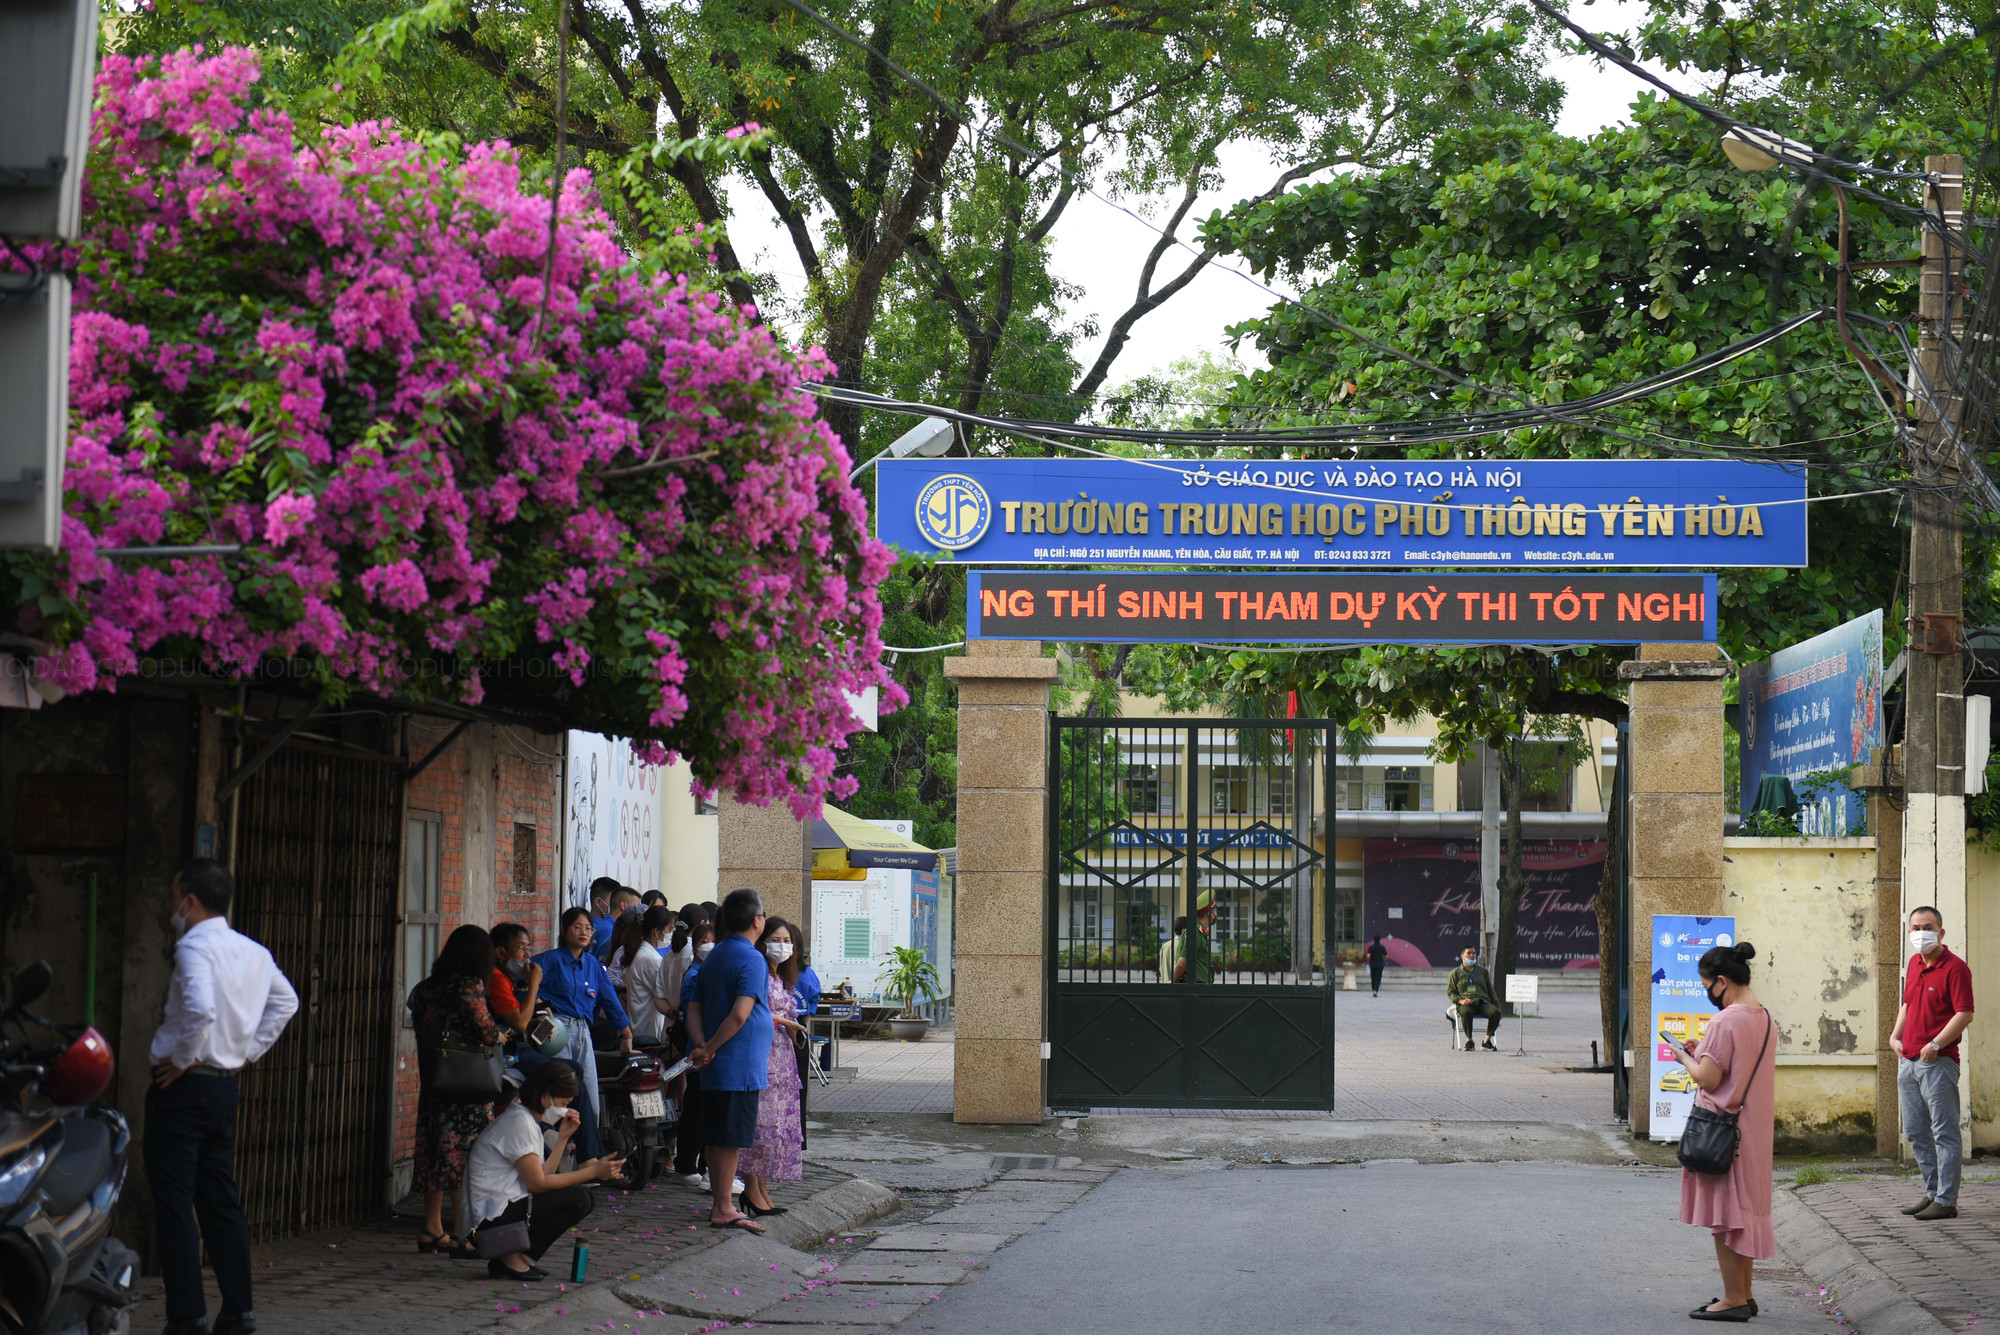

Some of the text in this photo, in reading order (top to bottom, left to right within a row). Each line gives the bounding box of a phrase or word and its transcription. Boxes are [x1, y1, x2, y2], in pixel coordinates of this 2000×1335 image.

[1182, 464, 1210, 487] SỞ
[1216, 464, 1268, 487] GIÁO
[1324, 465, 1348, 487] VÀ
[1354, 465, 1397, 487] ĐÀO
[1404, 471, 1443, 493] TẠO
[1451, 465, 1478, 487] HÀ
[1486, 466, 1521, 493] NỘI
[1000, 490, 1764, 543] TRƯỜNG TRUNG HỌC PHỔ THÔNG YÊN HÒA
[1034, 548, 1049, 560] ĐỊA
[1089, 549, 1105, 558] 251
[1106, 546, 1141, 559] NGUYỄN
[1142, 550, 1174, 560] KHANG,
[1175, 547, 1192, 559] YÊN
[1193, 547, 1213, 560] HÒA,
[1214, 547, 1232, 559] CẦU
[1233, 547, 1253, 560] GIẤY,
[1256, 549, 1269, 559] TP.
[1270, 548, 1282, 560] HÀ
[1284, 548, 1300, 561] NỘI
[1314, 550, 1328, 560] ĐT:
[1328, 550, 1351, 560] 0243
[1352, 550, 1370, 560] 833
[1370, 550, 1391, 560] 3721
[1404, 551, 1430, 560] Email:
[1524, 551, 1560, 560] Website:
[1561, 551, 1614, 562] c3yh.edu.vn
[980, 589, 1034, 618] NG
[1046, 583, 1107, 618] THÍ
[1117, 590, 1203, 619] SINH
[1215, 591, 1318, 620] THAM
[1330, 591, 1386, 628] DỰ
[1396, 585, 1447, 621] KỲ
[1457, 592, 1517, 621] THI
[1529, 585, 1605, 621] TỐT
[885, 856, 900, 864] Career
[907, 857, 918, 865] Care
[1677, 952, 1690, 961] be
[1660, 978, 1675, 987] Bứt
[1676, 979, 1693, 988] phá
[1660, 987, 1671, 995] có
[1672, 988, 1683, 996] be
[1684, 987, 1701, 998] tiếp
[637, 1104, 661, 1117] 4781
